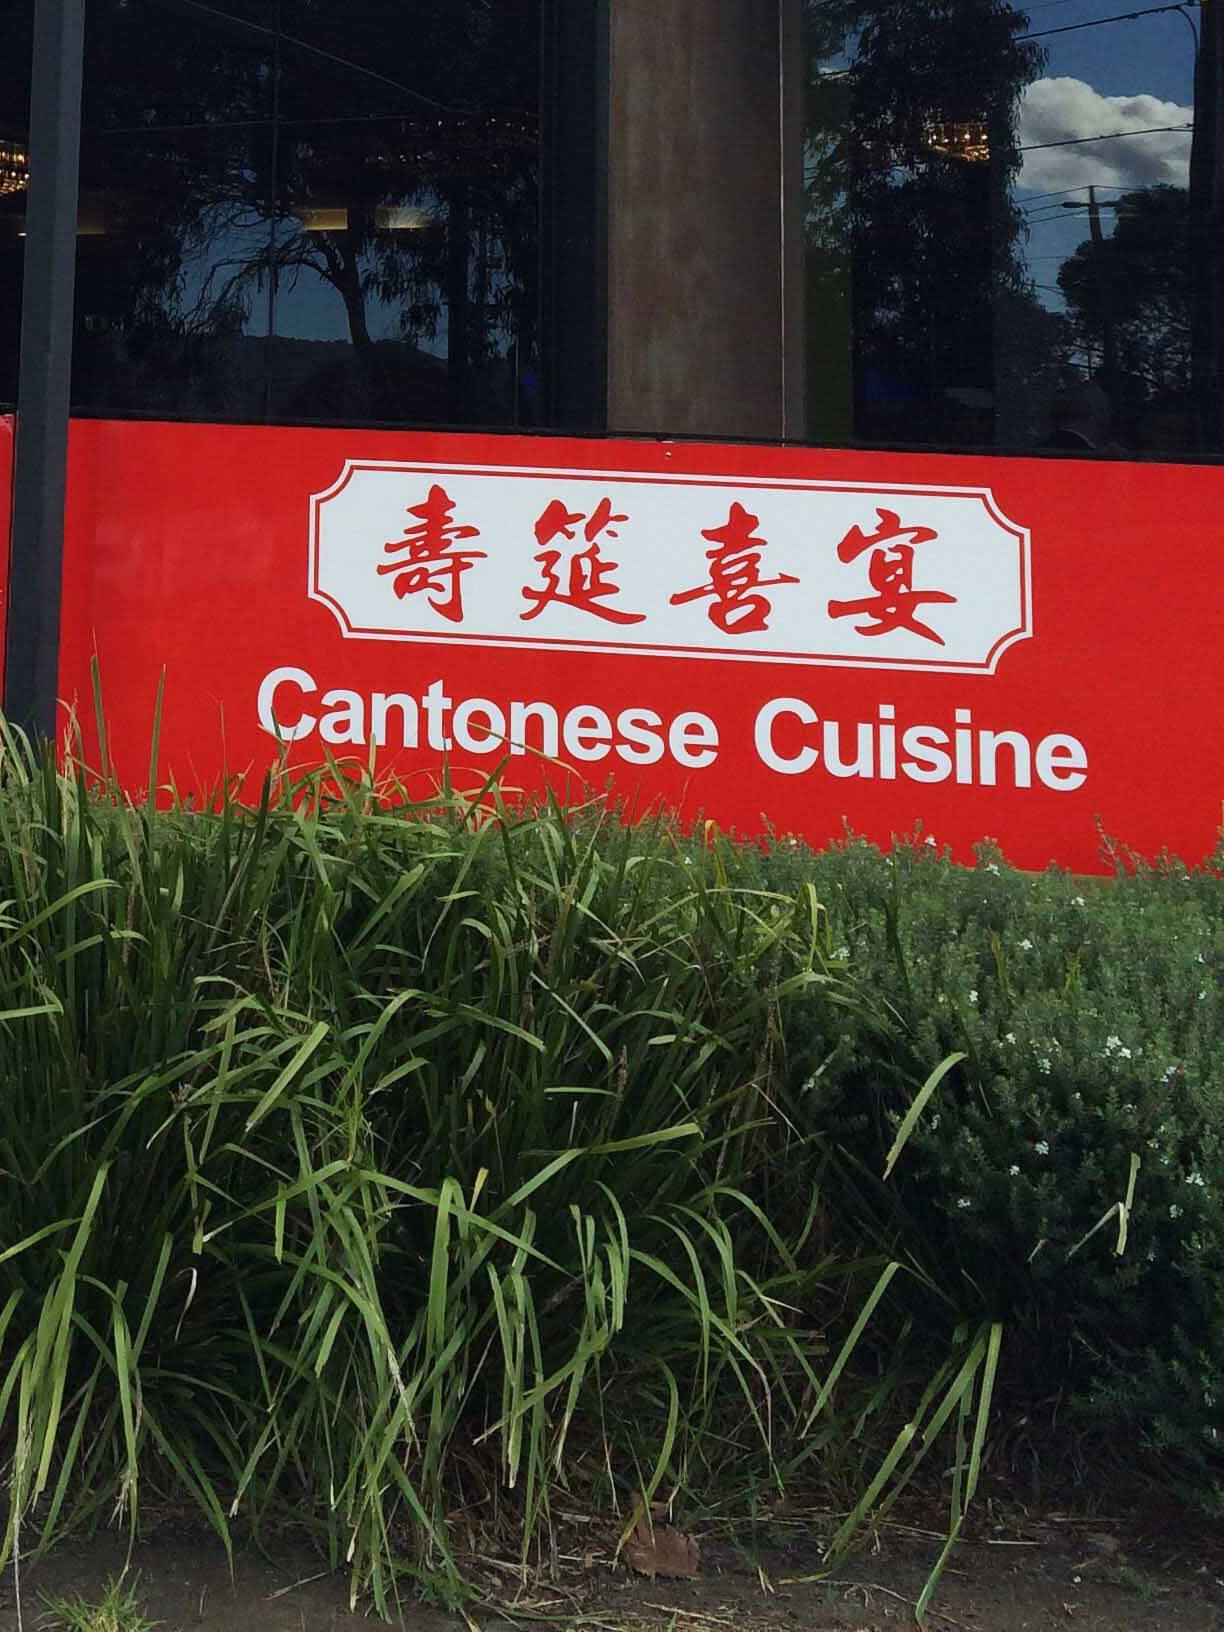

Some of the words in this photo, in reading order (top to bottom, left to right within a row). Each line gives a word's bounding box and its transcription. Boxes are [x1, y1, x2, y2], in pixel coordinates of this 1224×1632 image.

[376, 483, 957, 647] 壽筵喜宴
[256, 666, 720, 769] Cantonese
[754, 696, 1088, 792] Cuisine
